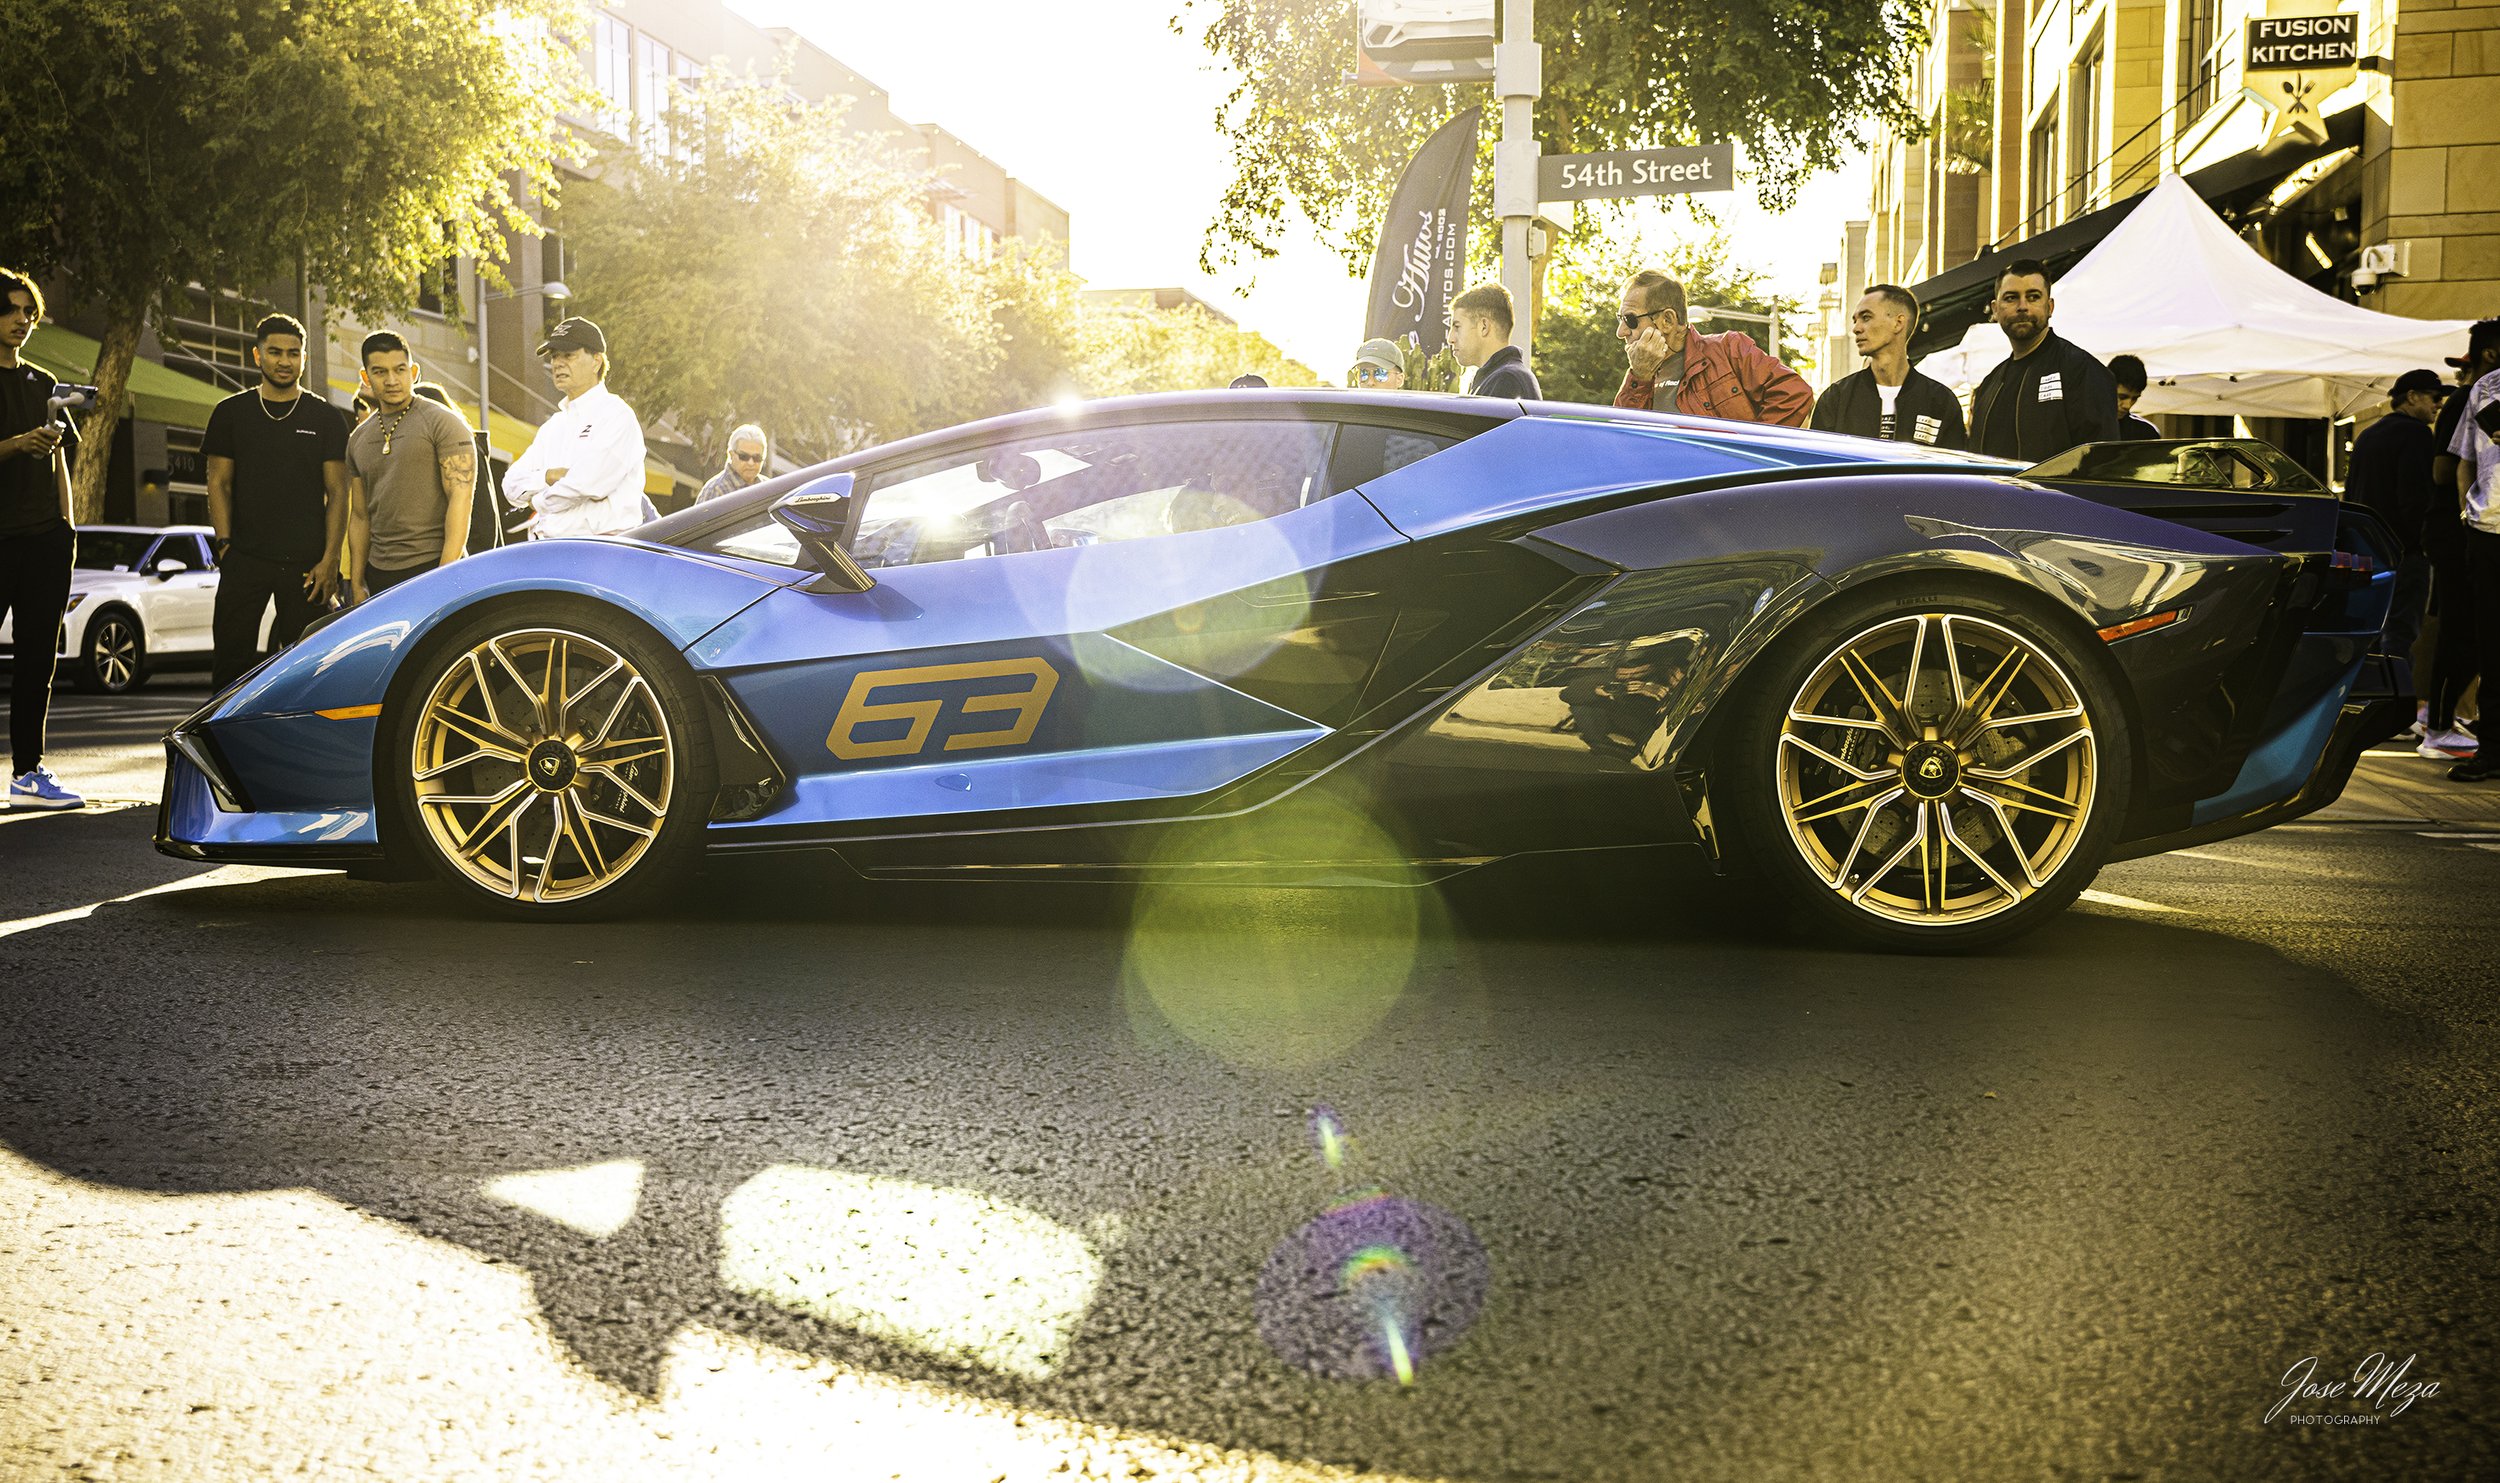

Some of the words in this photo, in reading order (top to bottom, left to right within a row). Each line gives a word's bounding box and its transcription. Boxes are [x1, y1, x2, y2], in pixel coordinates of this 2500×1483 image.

[2260, 17, 2351, 38] FUSION
[2252, 42, 2356, 63] KITCHEN
[1561, 160, 1623, 189] 54th
[1632, 157, 1713, 185] Street
[825, 656, 1060, 760] 63
